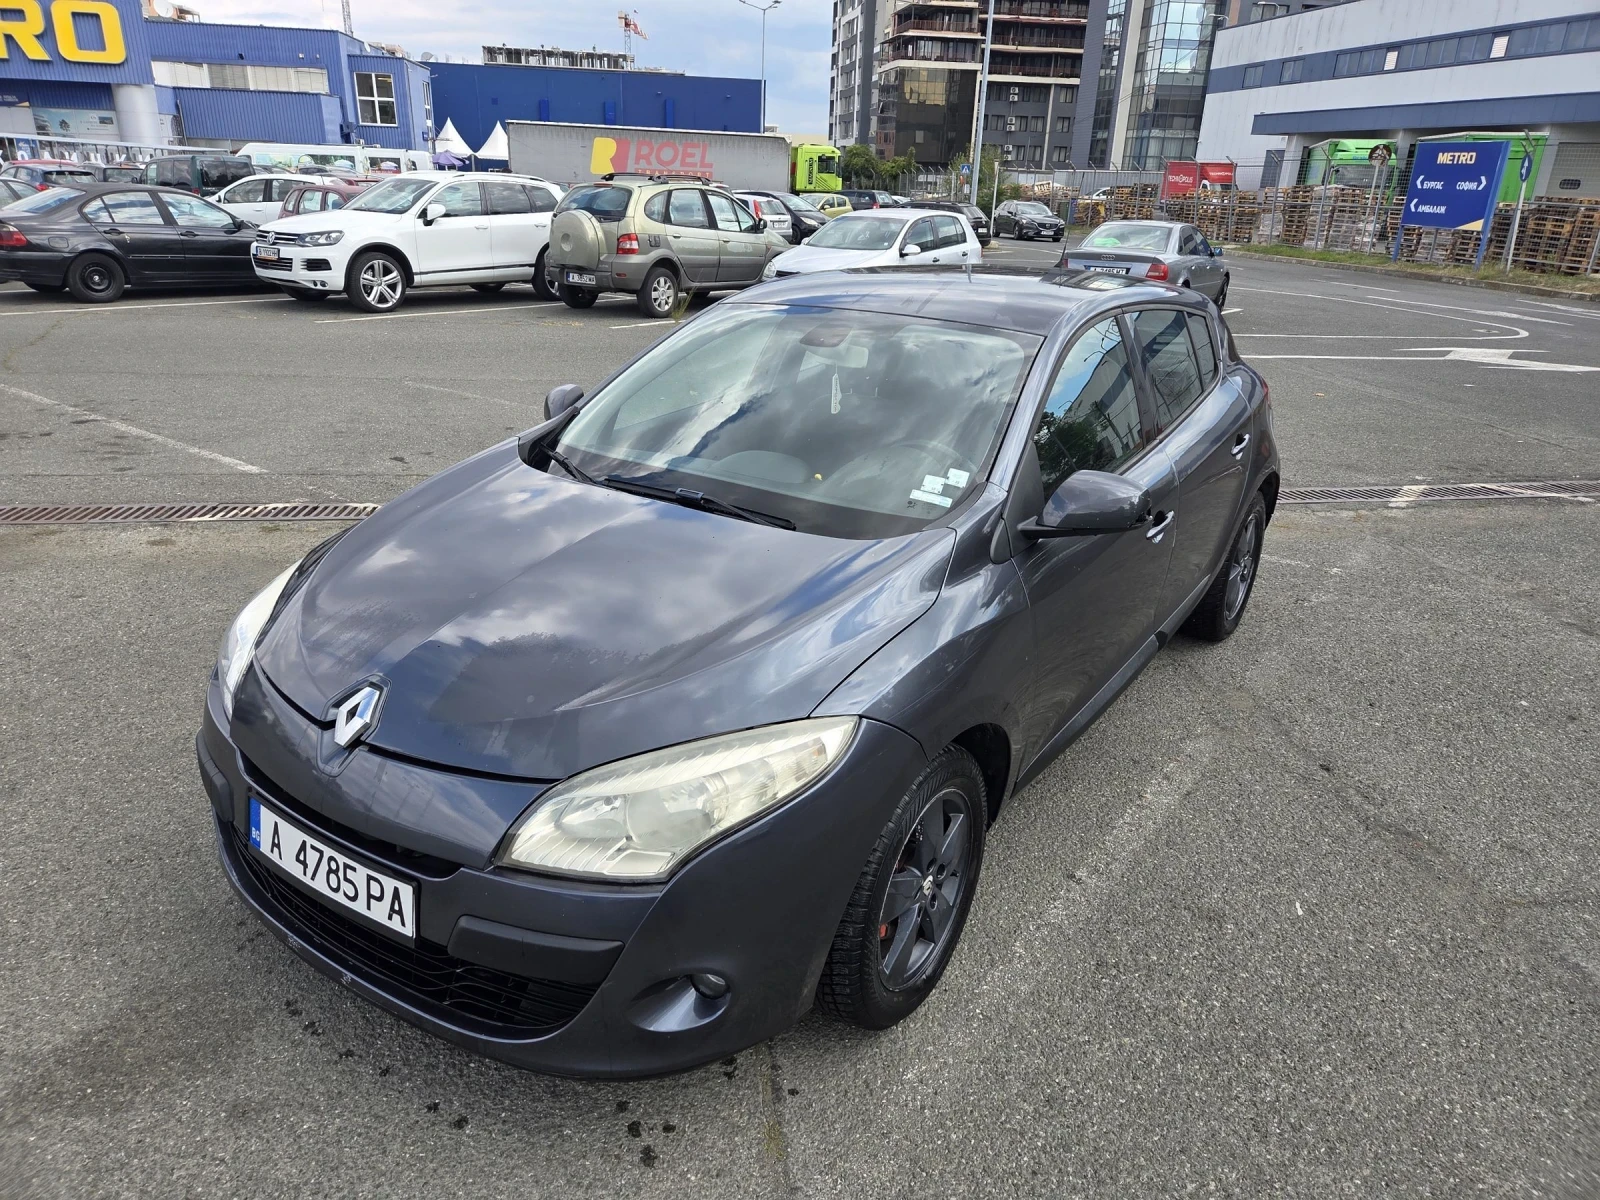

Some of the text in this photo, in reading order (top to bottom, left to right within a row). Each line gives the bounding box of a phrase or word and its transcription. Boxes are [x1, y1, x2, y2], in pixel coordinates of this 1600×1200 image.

[635, 139, 714, 169] ROEL
[1437, 152, 1477, 165] METRO
[1423, 180, 1478, 191] БУРГАС СОФИЯ
[1417, 204, 1447, 214] АМБАЛАЖ
[251, 820, 407, 928] BG A 4785 PA
